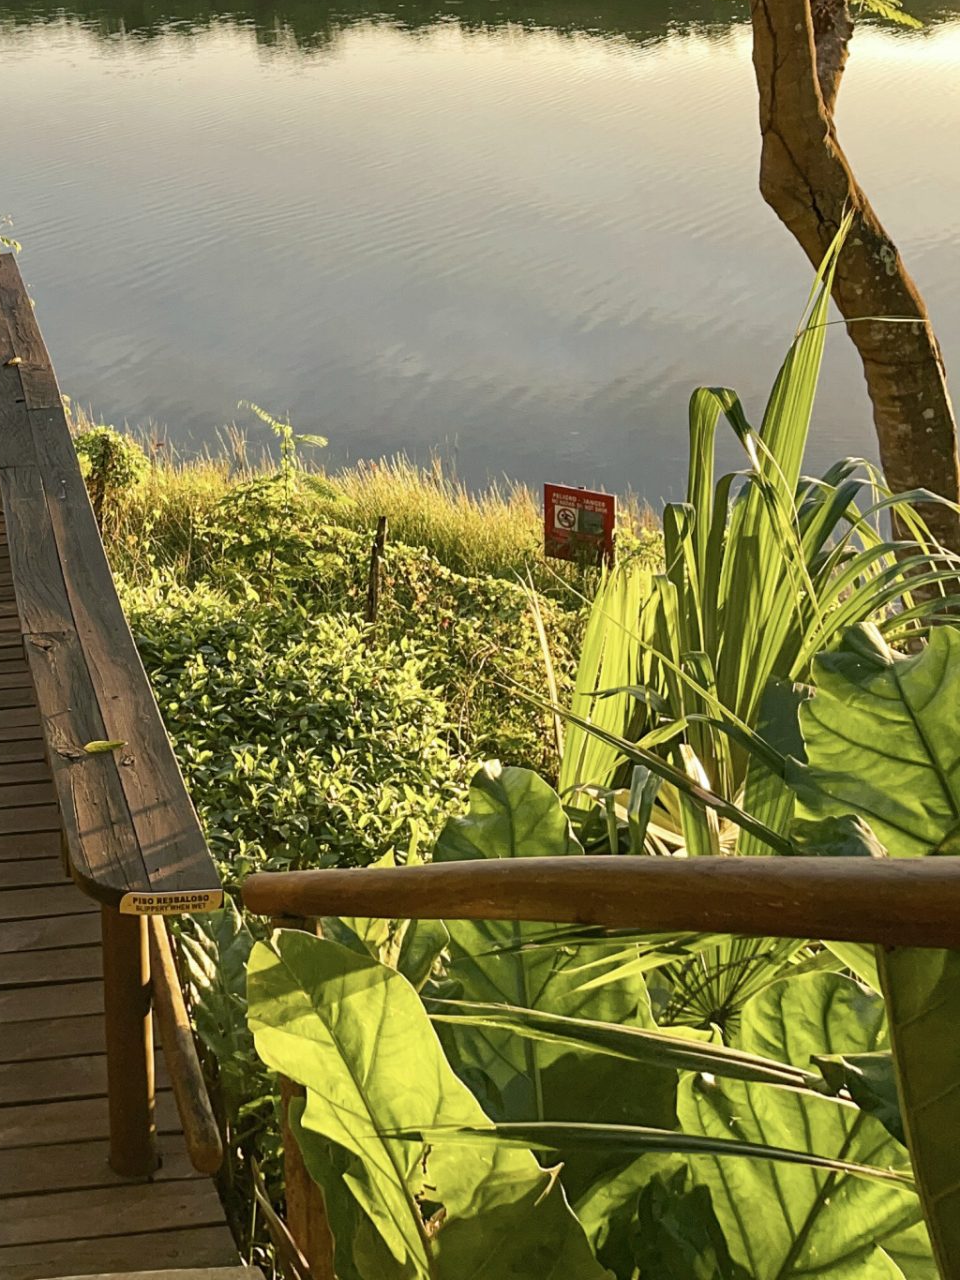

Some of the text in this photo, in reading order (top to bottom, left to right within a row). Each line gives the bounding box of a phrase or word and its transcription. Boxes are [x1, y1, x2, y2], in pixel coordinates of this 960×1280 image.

[157, 895, 209, 904] RESBALOSO
[170, 903, 190, 911] WHEN
[191, 902, 207, 910] WET
